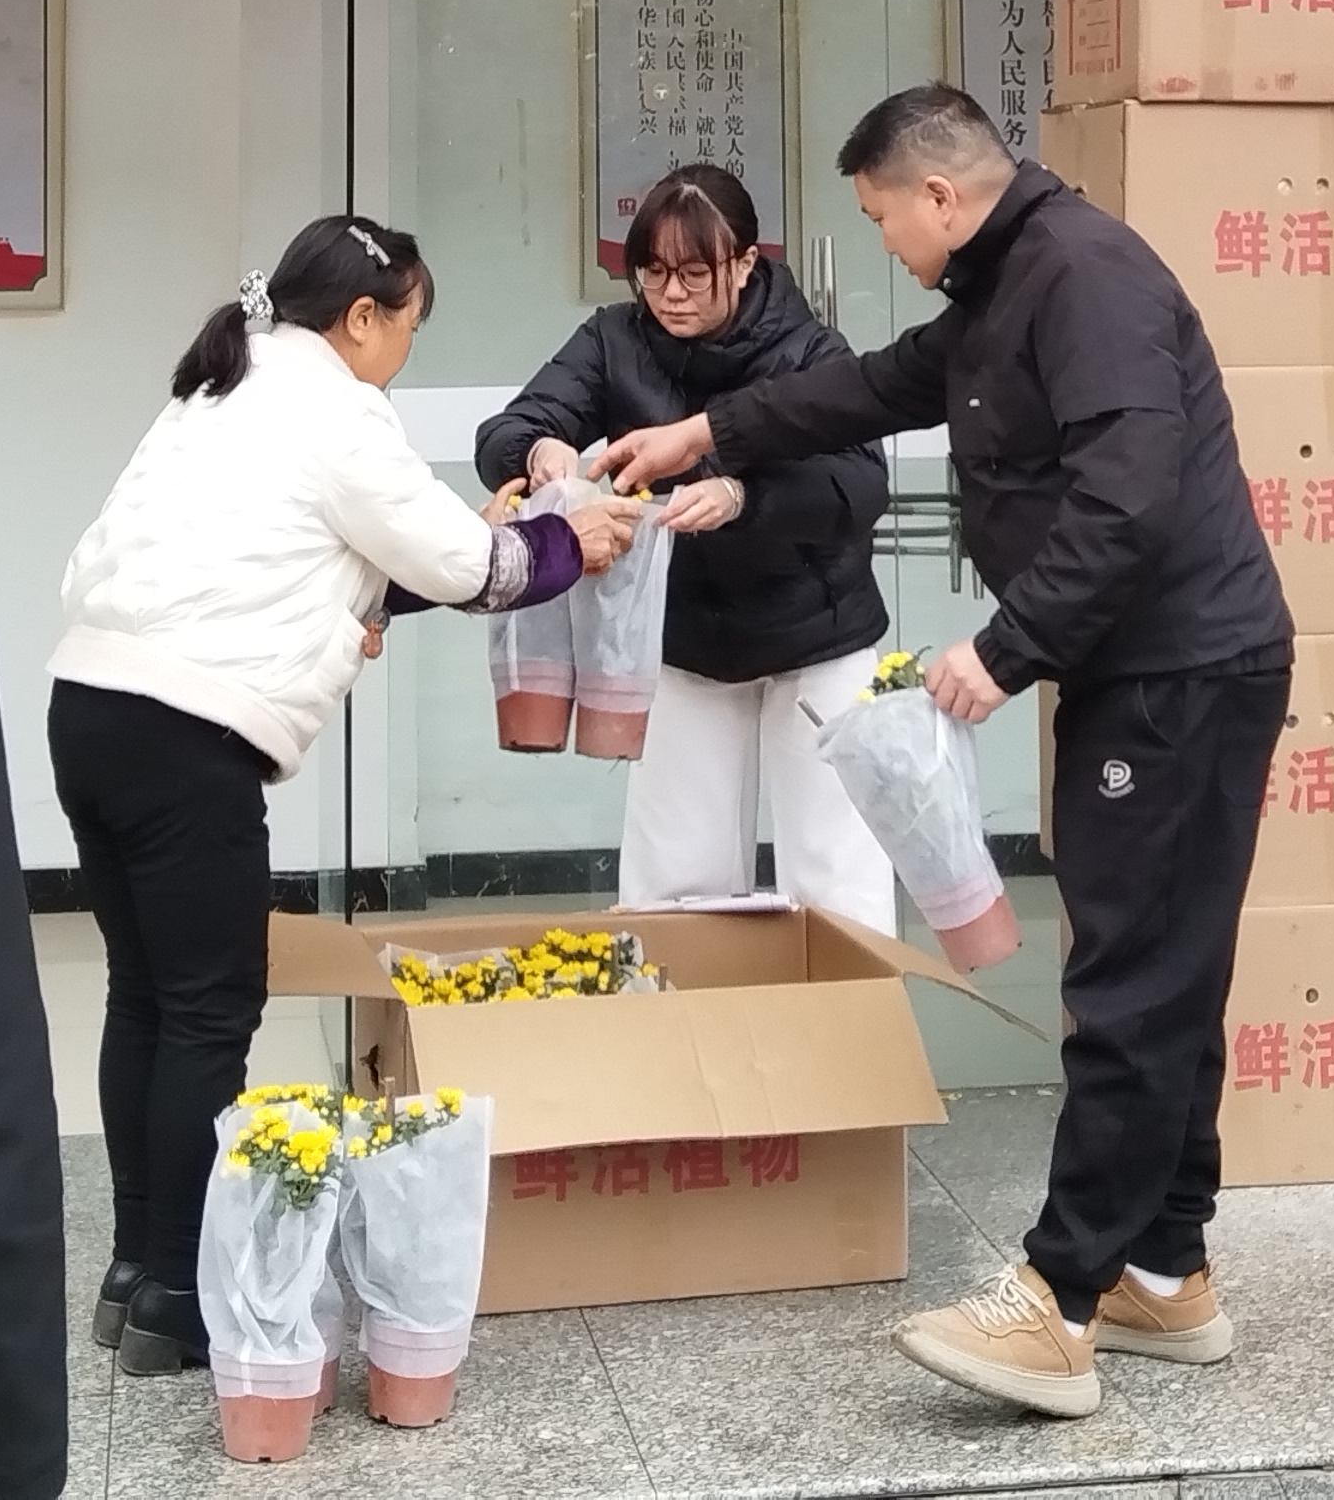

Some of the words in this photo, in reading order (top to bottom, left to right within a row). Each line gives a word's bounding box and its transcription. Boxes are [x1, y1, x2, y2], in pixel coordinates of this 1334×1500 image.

[723, 27, 746, 180] 中国共产党人的
